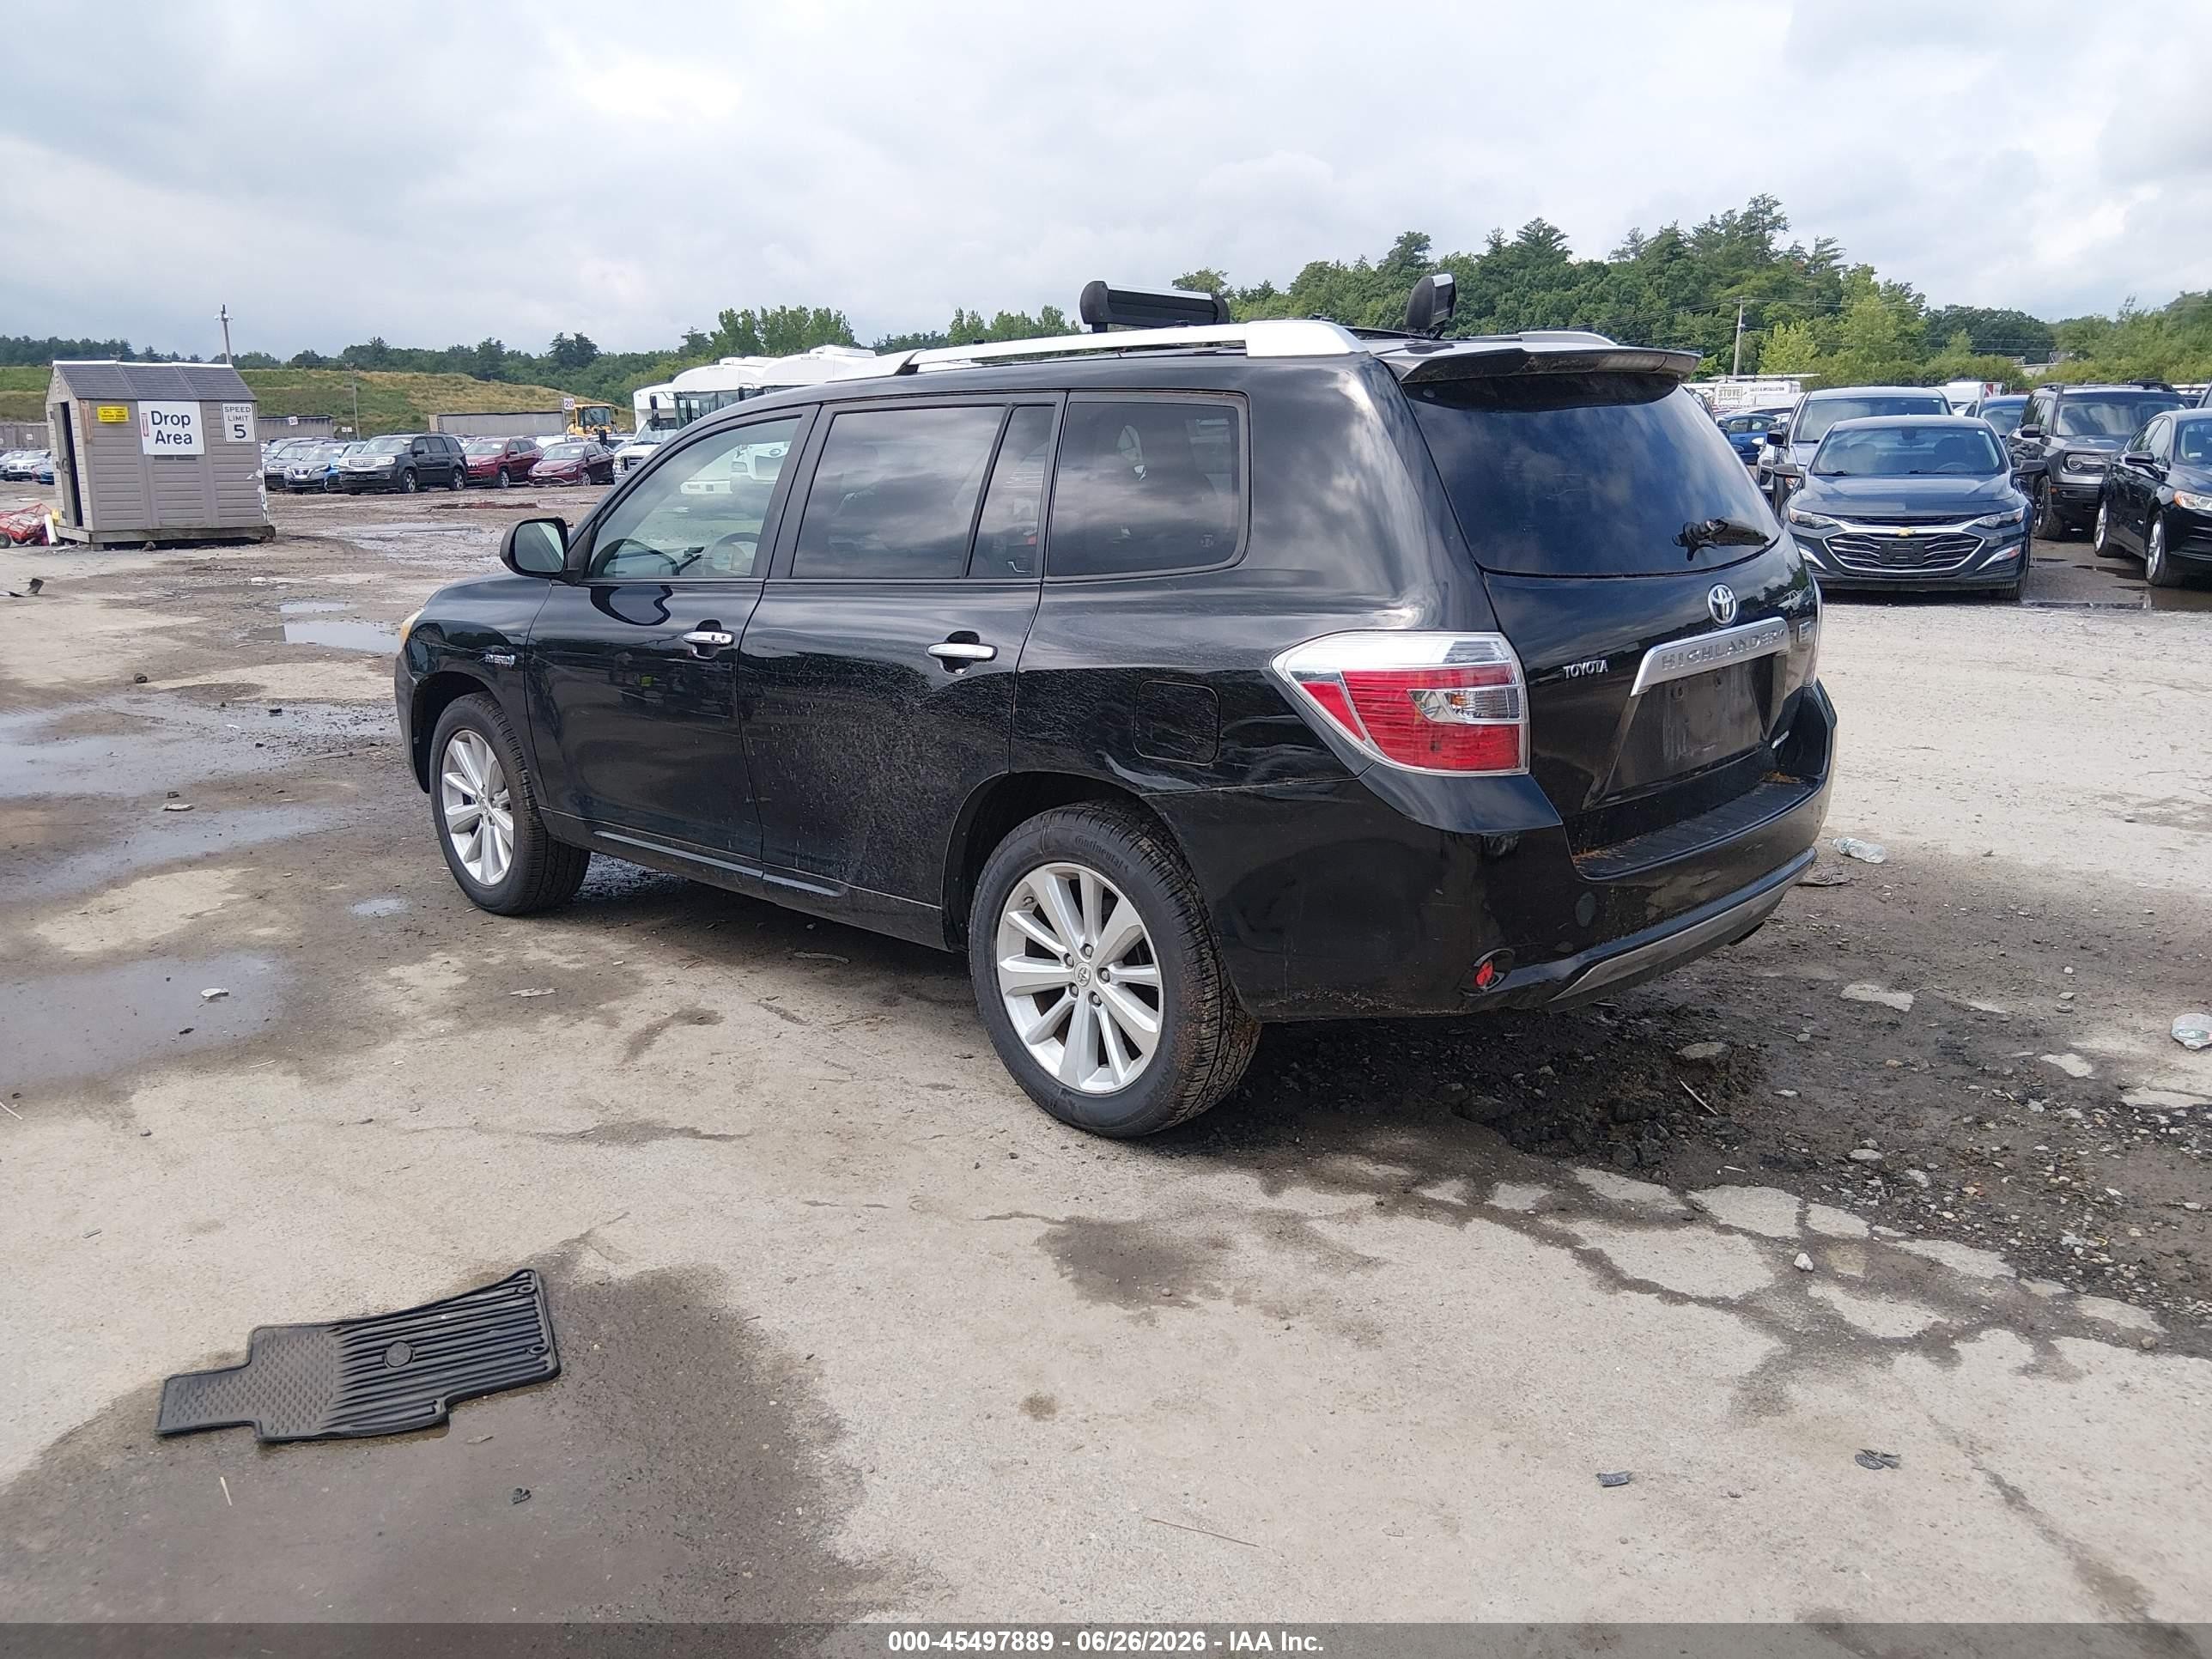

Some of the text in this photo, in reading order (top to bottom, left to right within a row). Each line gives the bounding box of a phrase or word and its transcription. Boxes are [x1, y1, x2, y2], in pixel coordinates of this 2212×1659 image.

[1718, 388, 1741, 397] STOVE
[150, 410, 191, 428] Drop
[155, 429, 193, 445] Area
[234, 424, 247, 439] 5
[1662, 629, 1784, 671] HIGHLANDER
[1563, 659, 1608, 679] TOYOTA
